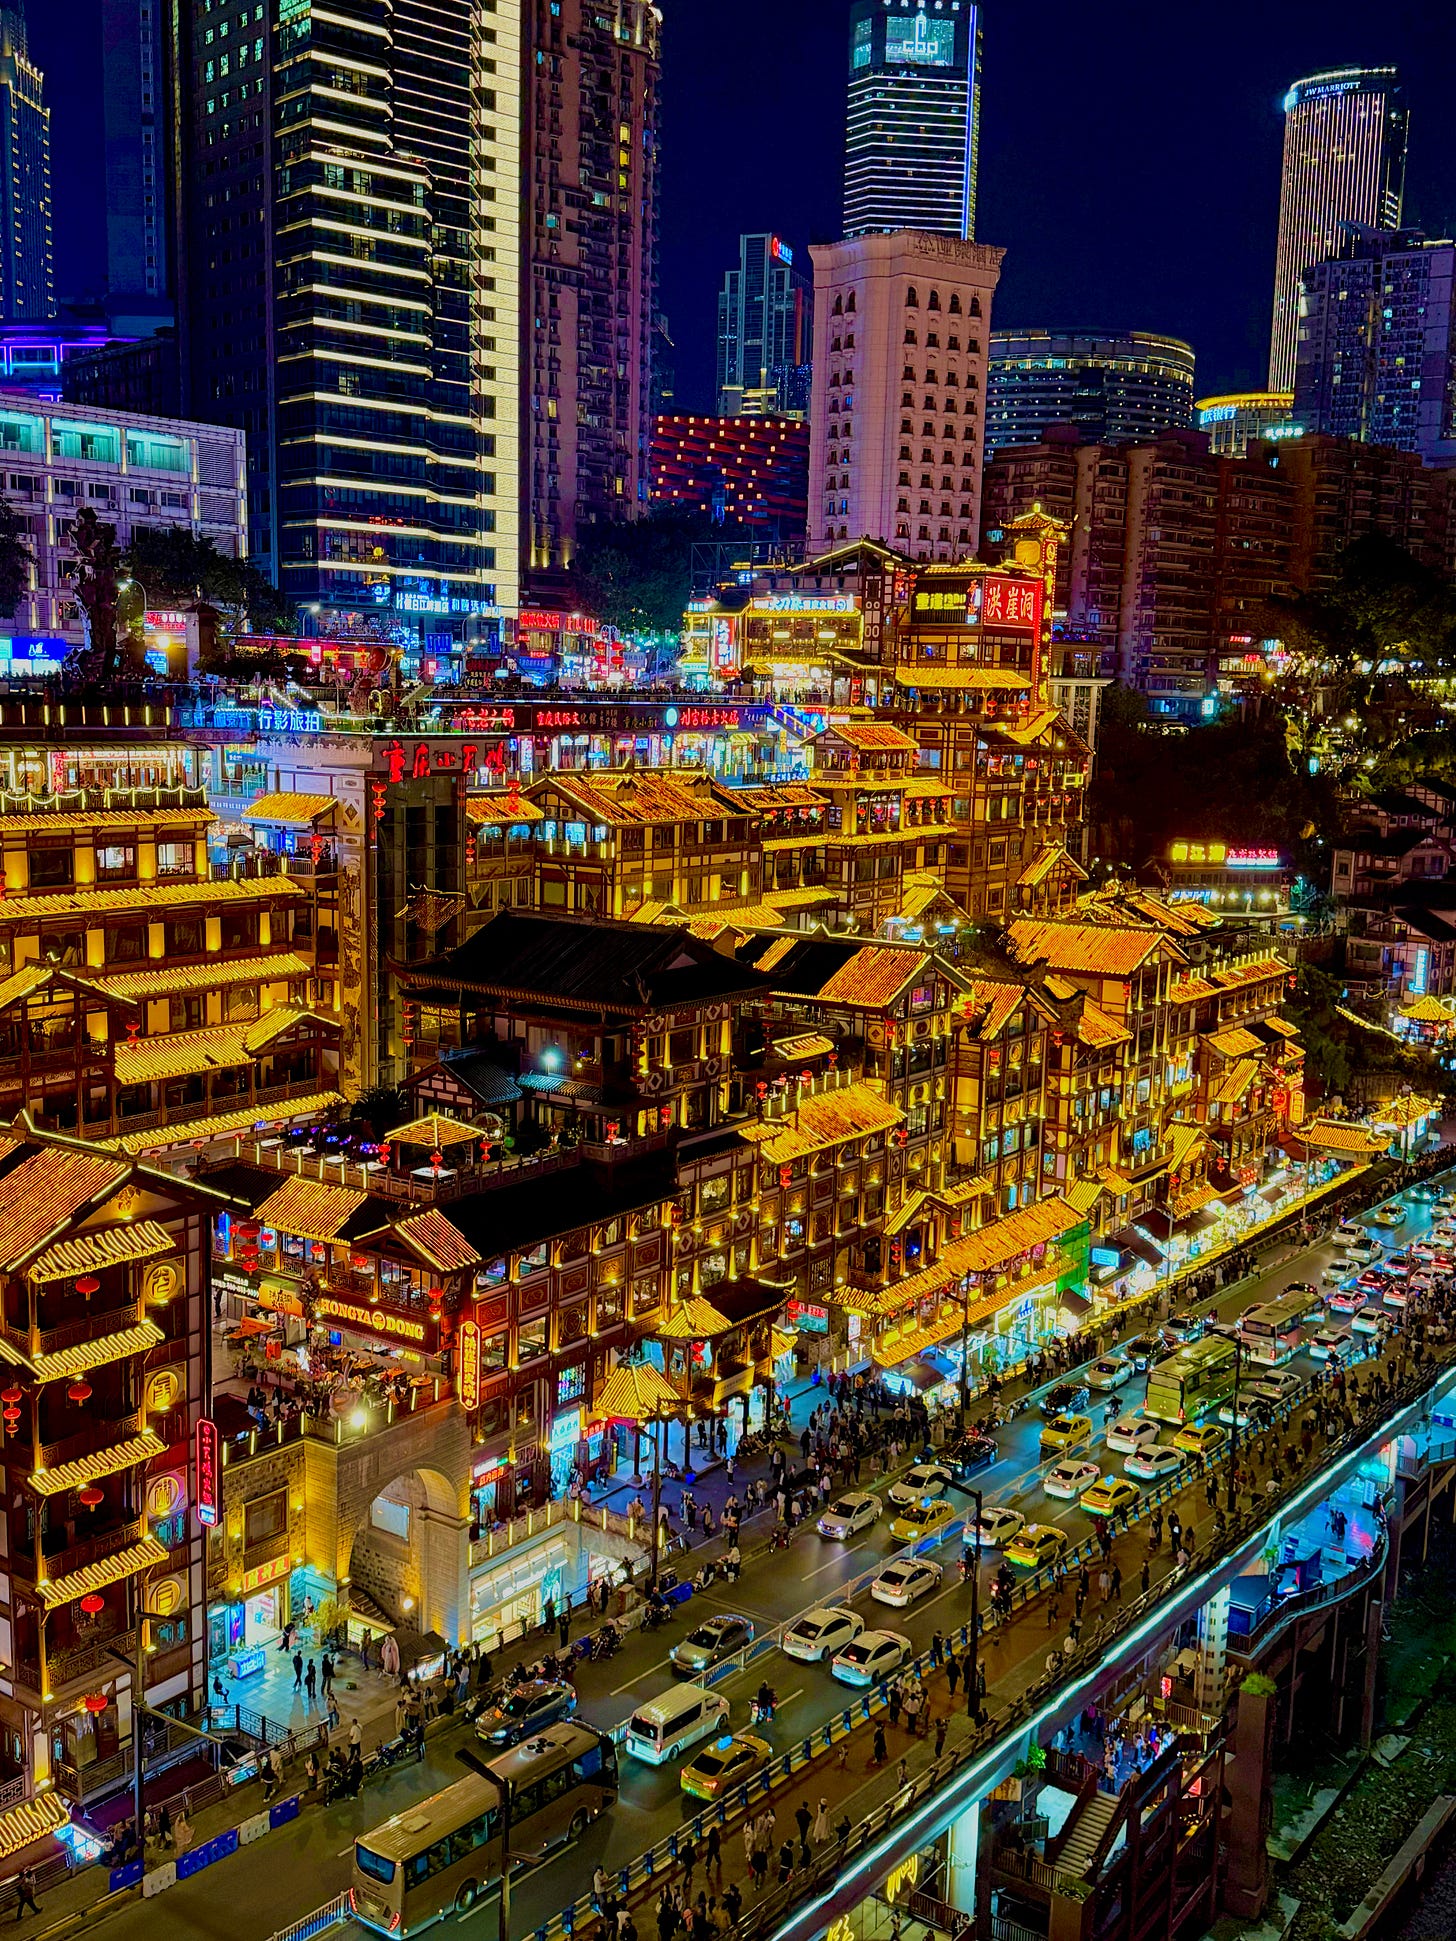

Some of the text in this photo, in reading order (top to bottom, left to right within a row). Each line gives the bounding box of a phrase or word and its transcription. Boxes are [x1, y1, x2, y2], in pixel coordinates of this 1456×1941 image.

[1304, 81, 1361, 97] JW MARRIOTT
[986, 584, 1034, 621] 洪崖洞
[258, 709, 320, 732] 行影旅拍
[536, 711, 598, 728] 重庆民俗文化馆
[622, 715, 654, 729] 重庆小面
[320, 1298, 425, 1341] HONGYA DONG
[463, 1335, 477, 1399] 洪崖洞火锅
